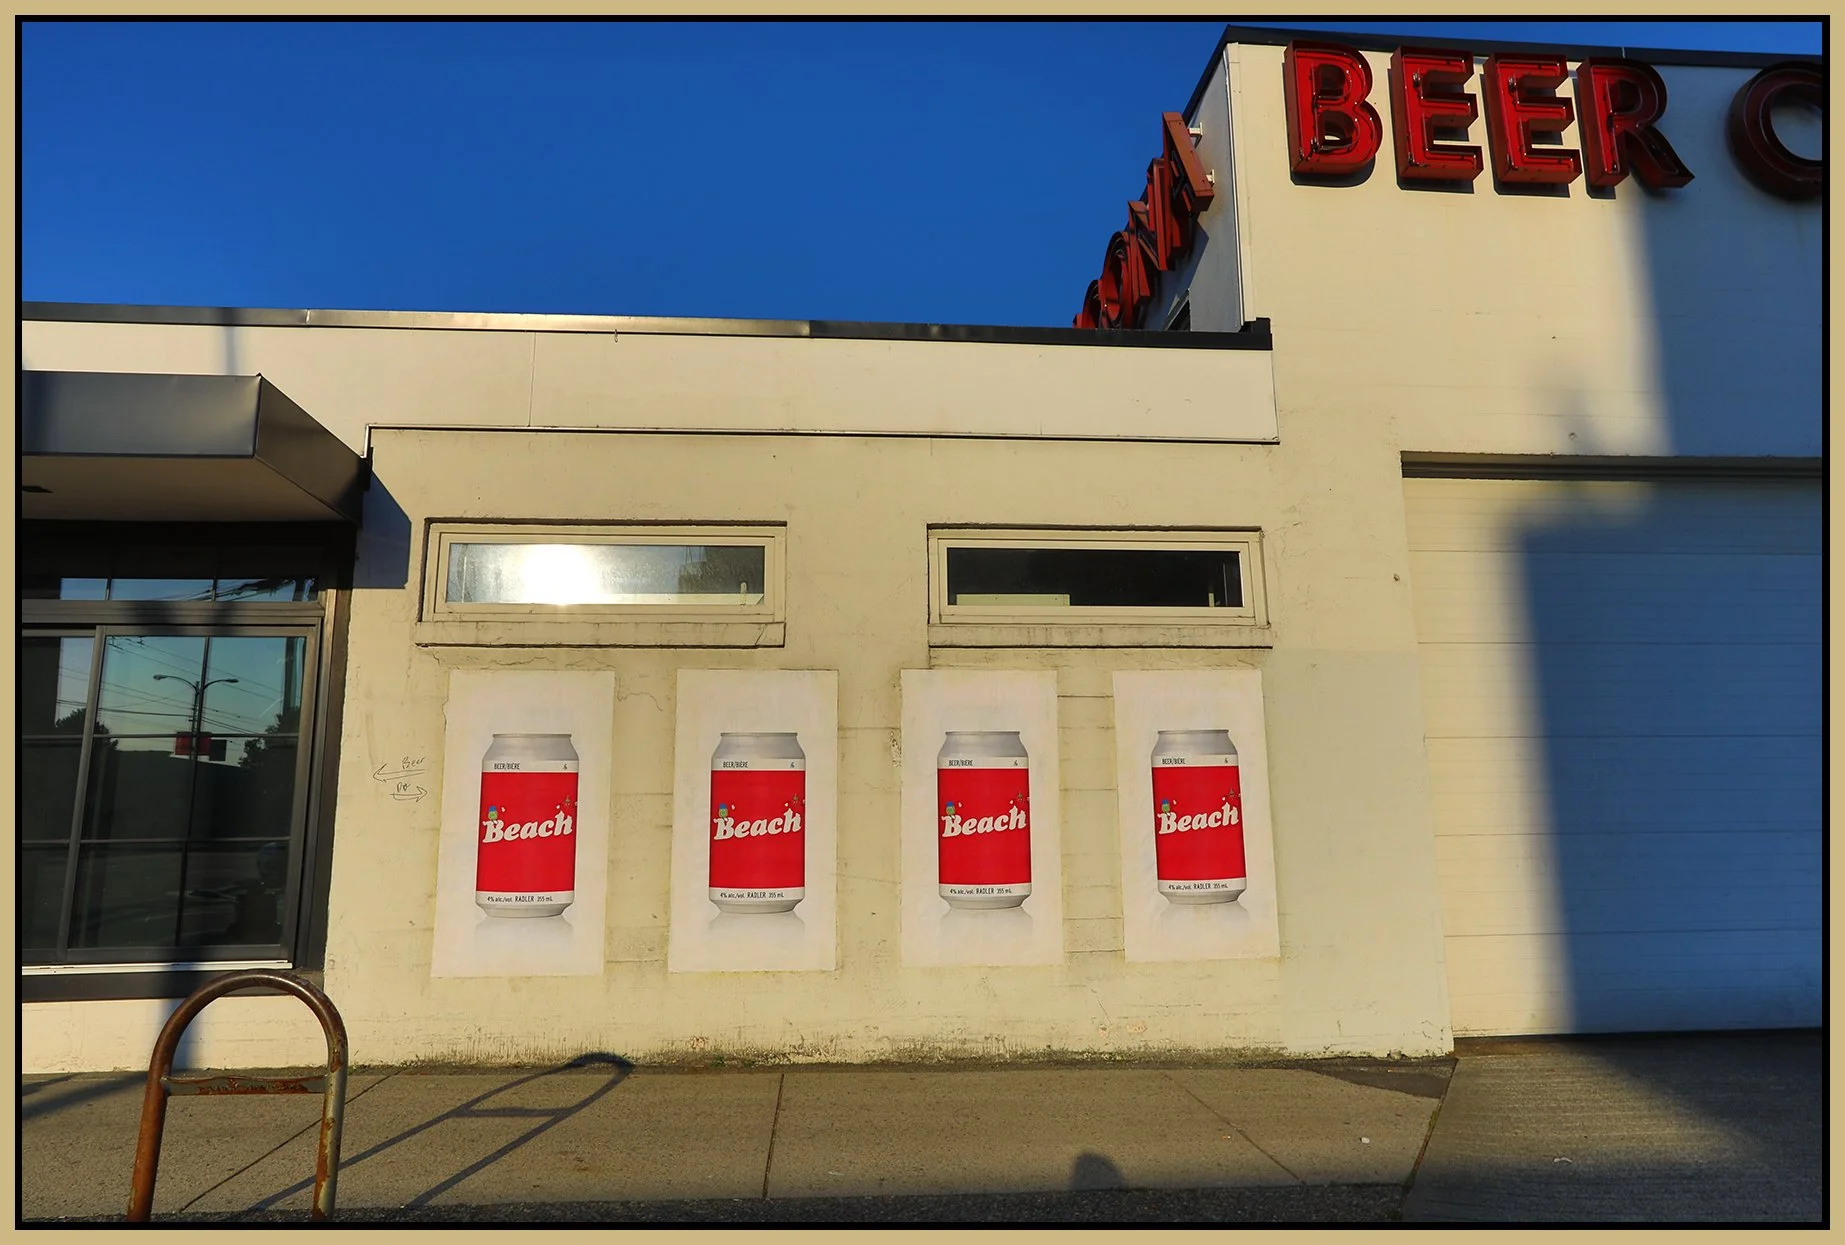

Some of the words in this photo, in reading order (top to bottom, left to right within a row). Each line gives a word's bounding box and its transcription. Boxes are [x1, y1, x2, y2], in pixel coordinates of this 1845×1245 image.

[1284, 40, 1695, 189] BEER
[482, 810, 573, 843] Beach
[713, 808, 802, 840] Beach
[941, 805, 1027, 838] Beach
[1157, 802, 1239, 835] Beach
